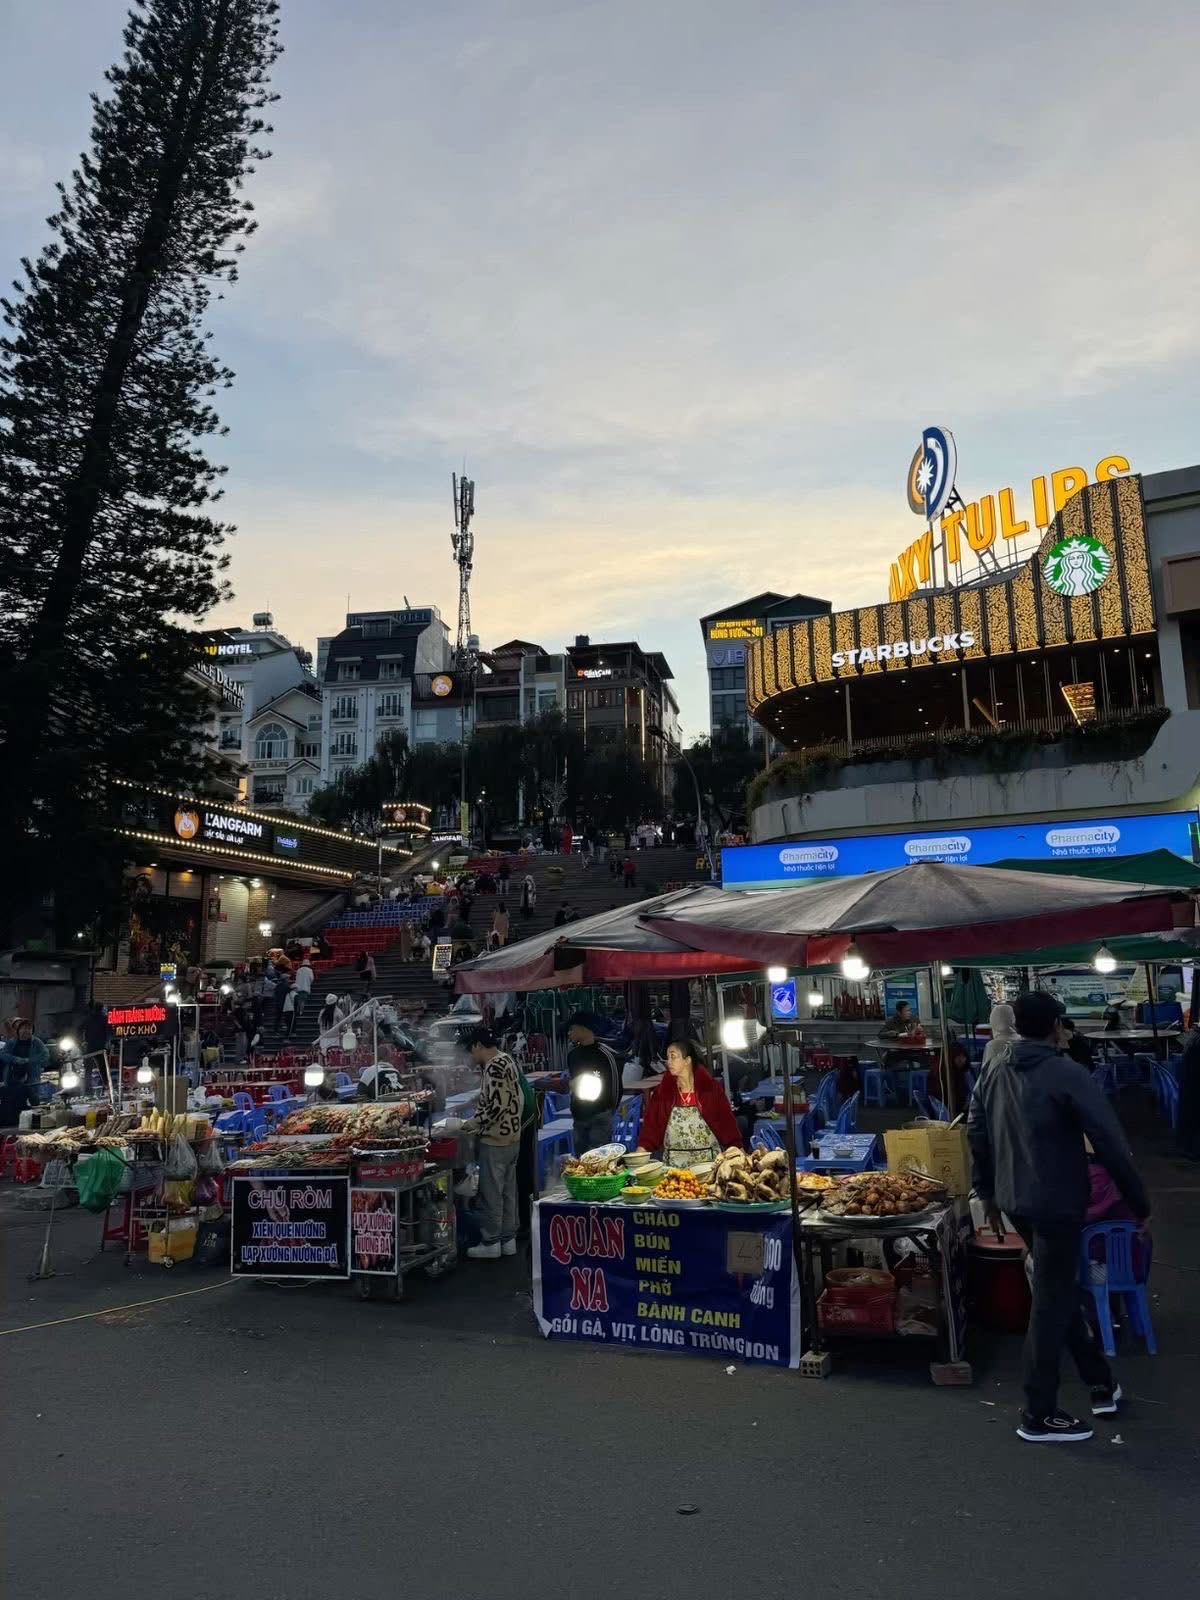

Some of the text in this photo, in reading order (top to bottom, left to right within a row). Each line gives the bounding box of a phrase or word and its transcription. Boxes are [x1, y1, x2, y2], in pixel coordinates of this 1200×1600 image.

[218, 643, 253, 655] HOTEL
[831, 631, 975, 668] STARBUCKS
[205, 812, 263, 838] L'ANGFARM
[908, 838, 967, 854] Pharmacity
[1050, 828, 1115, 845] Pharmacity
[782, 848, 835, 863] Pharmacity
[290, 1185, 332, 1209] RÒM
[632, 1210, 680, 1227] CHÁO
[274, 1221, 293, 1240] QUE
[634, 1232, 671, 1250] BÚN
[570, 1267, 609, 1312] NA
[551, 1314, 577, 1333] GỎI
[637, 1300, 741, 1329] BÁNH CANH
